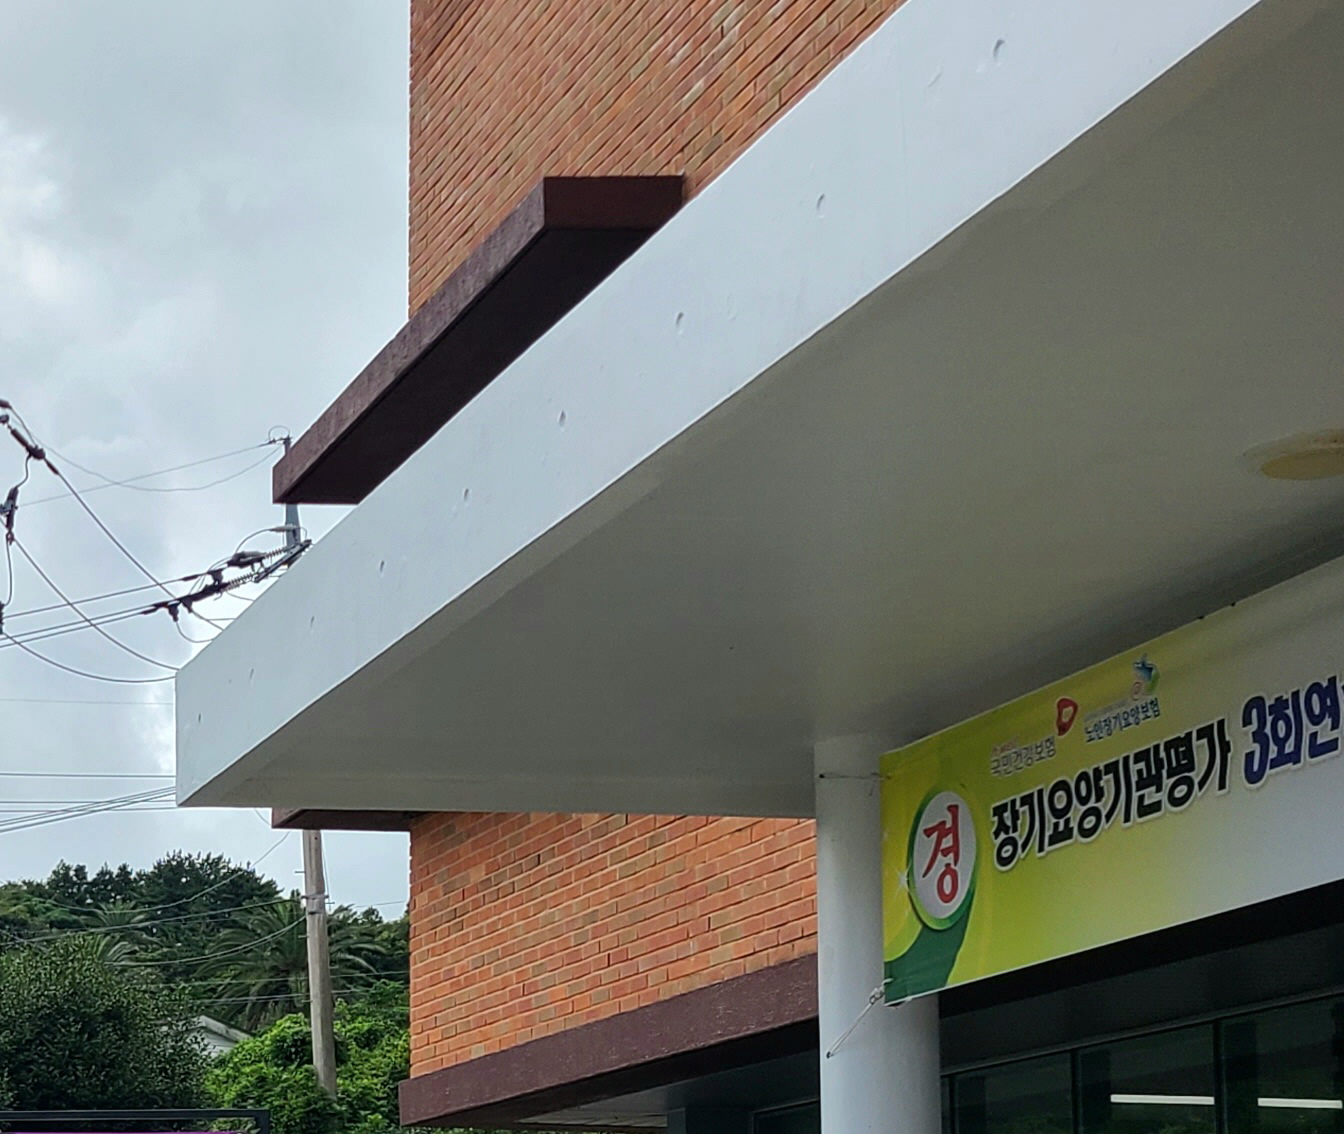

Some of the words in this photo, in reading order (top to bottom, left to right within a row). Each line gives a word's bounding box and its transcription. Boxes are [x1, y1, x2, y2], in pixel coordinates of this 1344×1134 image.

[990, 736, 1057, 777] 국민건강보험
[991, 716, 1232, 869] 장기요양기관평가
[1242, 674, 1344, 785] 3회연
[921, 803, 962, 904] 경
